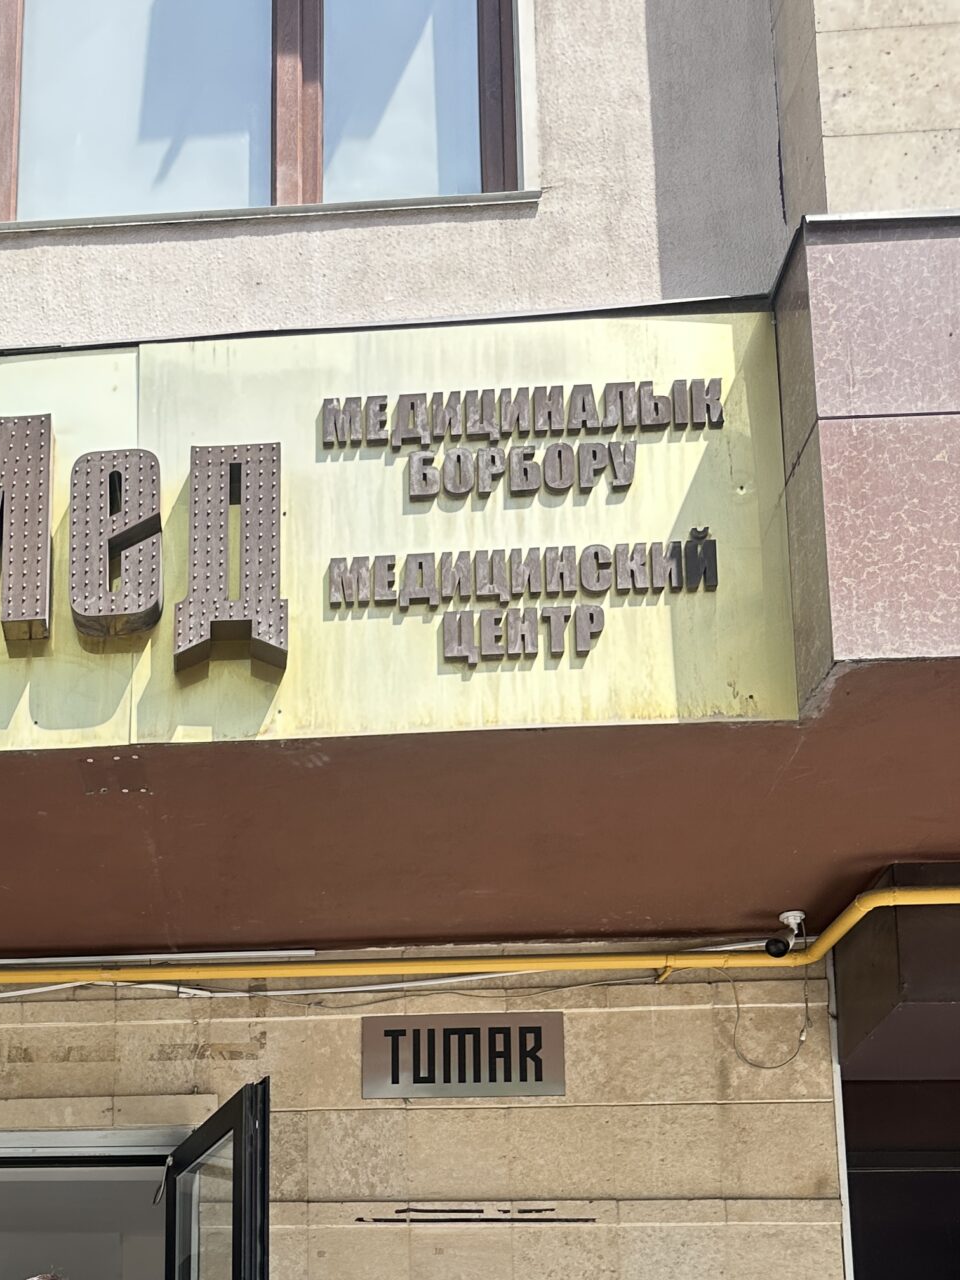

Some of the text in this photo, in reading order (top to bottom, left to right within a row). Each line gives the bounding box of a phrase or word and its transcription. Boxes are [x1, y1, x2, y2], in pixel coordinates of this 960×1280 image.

[322, 377, 725, 448] МЕДИЦИНАЛЫК
[408, 440, 638, 501] БОРБОРУ
[328, 526, 719, 612] МЕДИЦИНСКИЙ
[443, 604, 605, 666] ЦЕНТР
[383, 1025, 544, 1085] TUMAR
